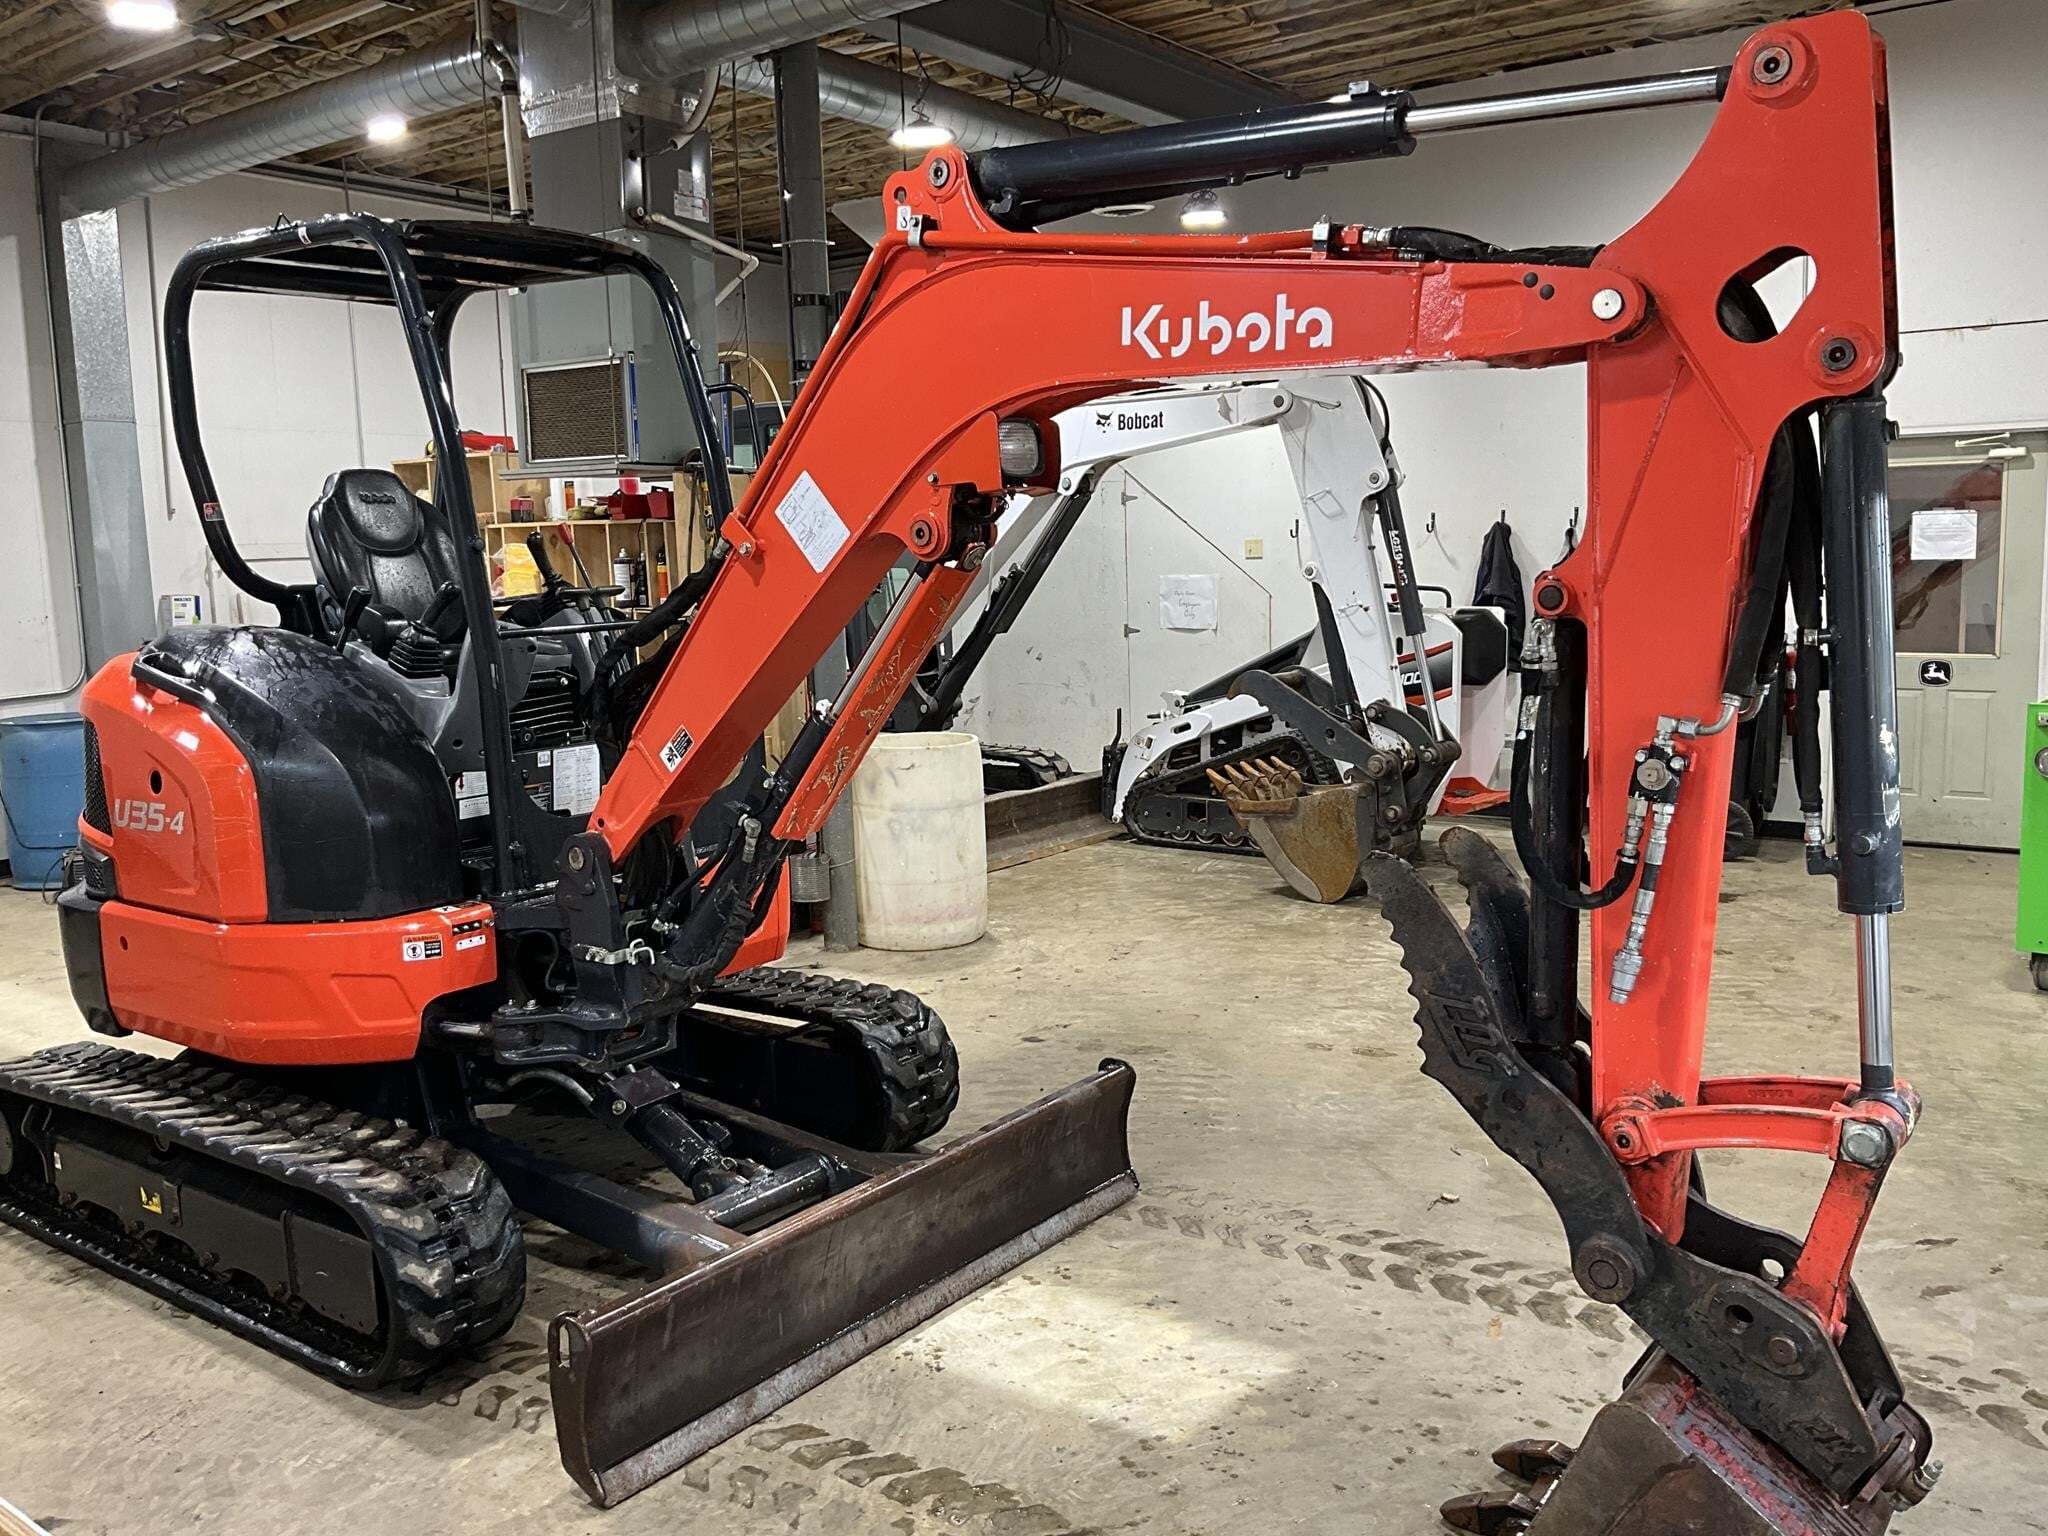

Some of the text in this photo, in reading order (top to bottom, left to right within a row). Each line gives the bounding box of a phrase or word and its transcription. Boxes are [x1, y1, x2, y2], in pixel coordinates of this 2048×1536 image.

[1121, 293, 1333, 359] Kubota
[1118, 411, 1164, 431] Bobcat
[114, 798, 185, 835] U35-4
